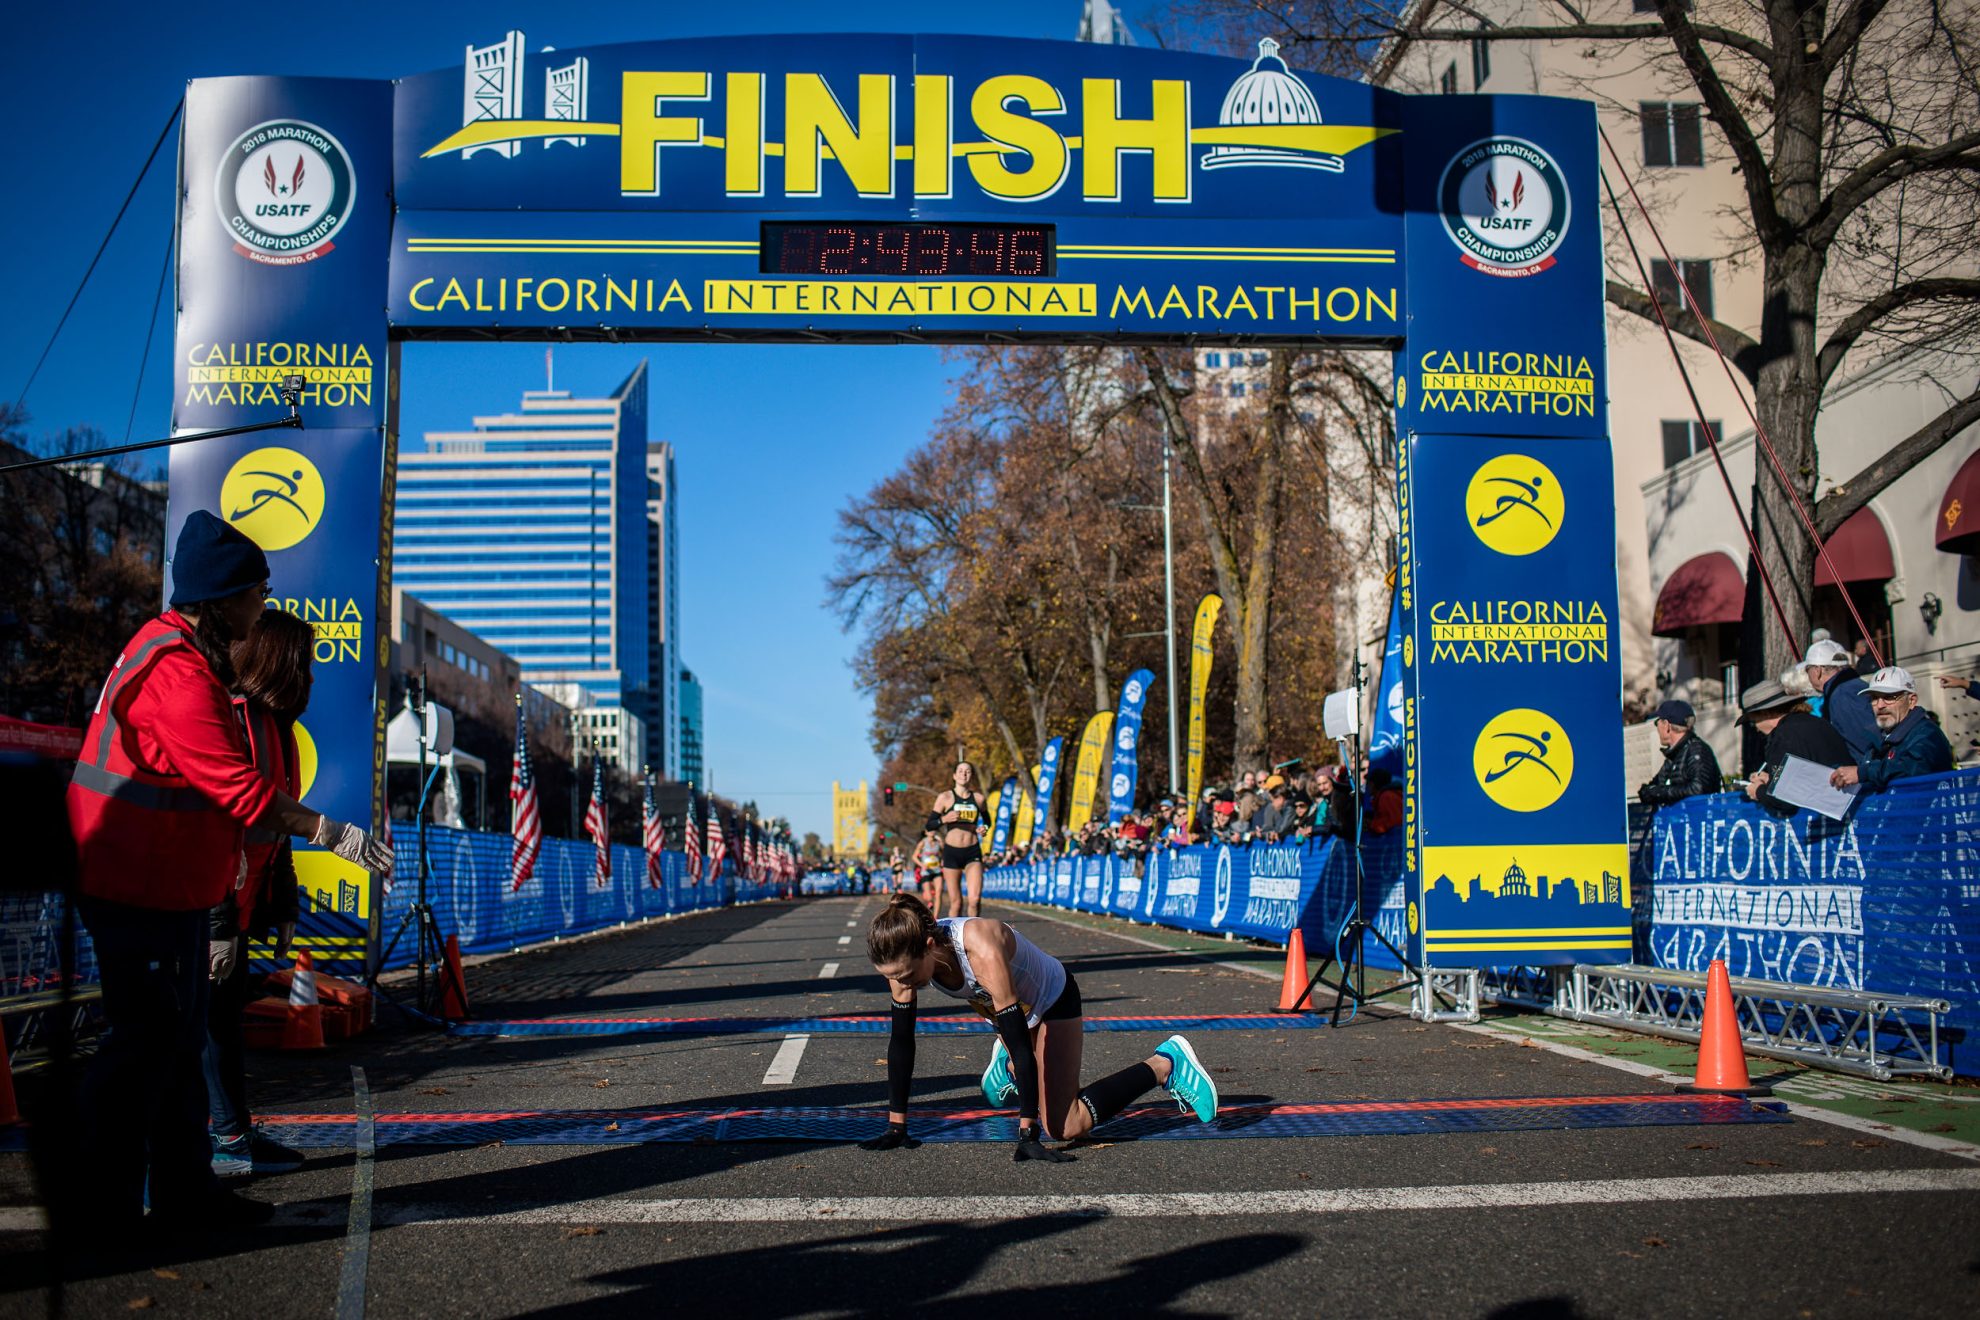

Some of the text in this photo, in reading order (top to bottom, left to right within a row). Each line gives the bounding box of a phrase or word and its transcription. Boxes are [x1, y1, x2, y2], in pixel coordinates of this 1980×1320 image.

[242, 128, 331, 153] 2018 MARATHON
[621, 71, 1192, 203] FINISH
[1487, 144, 1547, 170] MARATHON
[256, 204, 311, 217] USATF
[1480, 217, 1532, 230] USATF
[232, 214, 337, 250] CHAMPIONSHIPS
[1457, 227, 1557, 262] CHAMPIONSHIPS
[250, 251, 318, 265] SACRAMENTO, CA
[1477, 263, 1541, 277] SACRAMENTO, CA
[409, 277, 1397, 323] CALIFORNIA INTERNATIONAL MARATHON
[188, 342, 374, 366] CALIFORNIA
[1421, 350, 1594, 379] CALIFORNIA
[185, 383, 372, 407] MARAHON
[1424, 375, 1592, 393] INTERNATIONAL
[1420, 390, 1594, 417] MARATHON
[381, 432, 397, 607] #RUNCIM
[1399, 438, 1412, 611] #RUNCIM
[1430, 600, 1608, 624] CALIFORNIA
[1433, 625, 1606, 639] INTERNATIONAL
[1430, 640, 1608, 664] MARATHON
[373, 698, 386, 840] UNCIM
[1406, 697, 1416, 872] #RUNCIM
[1654, 888, 1861, 931] NTERNATIONAL
